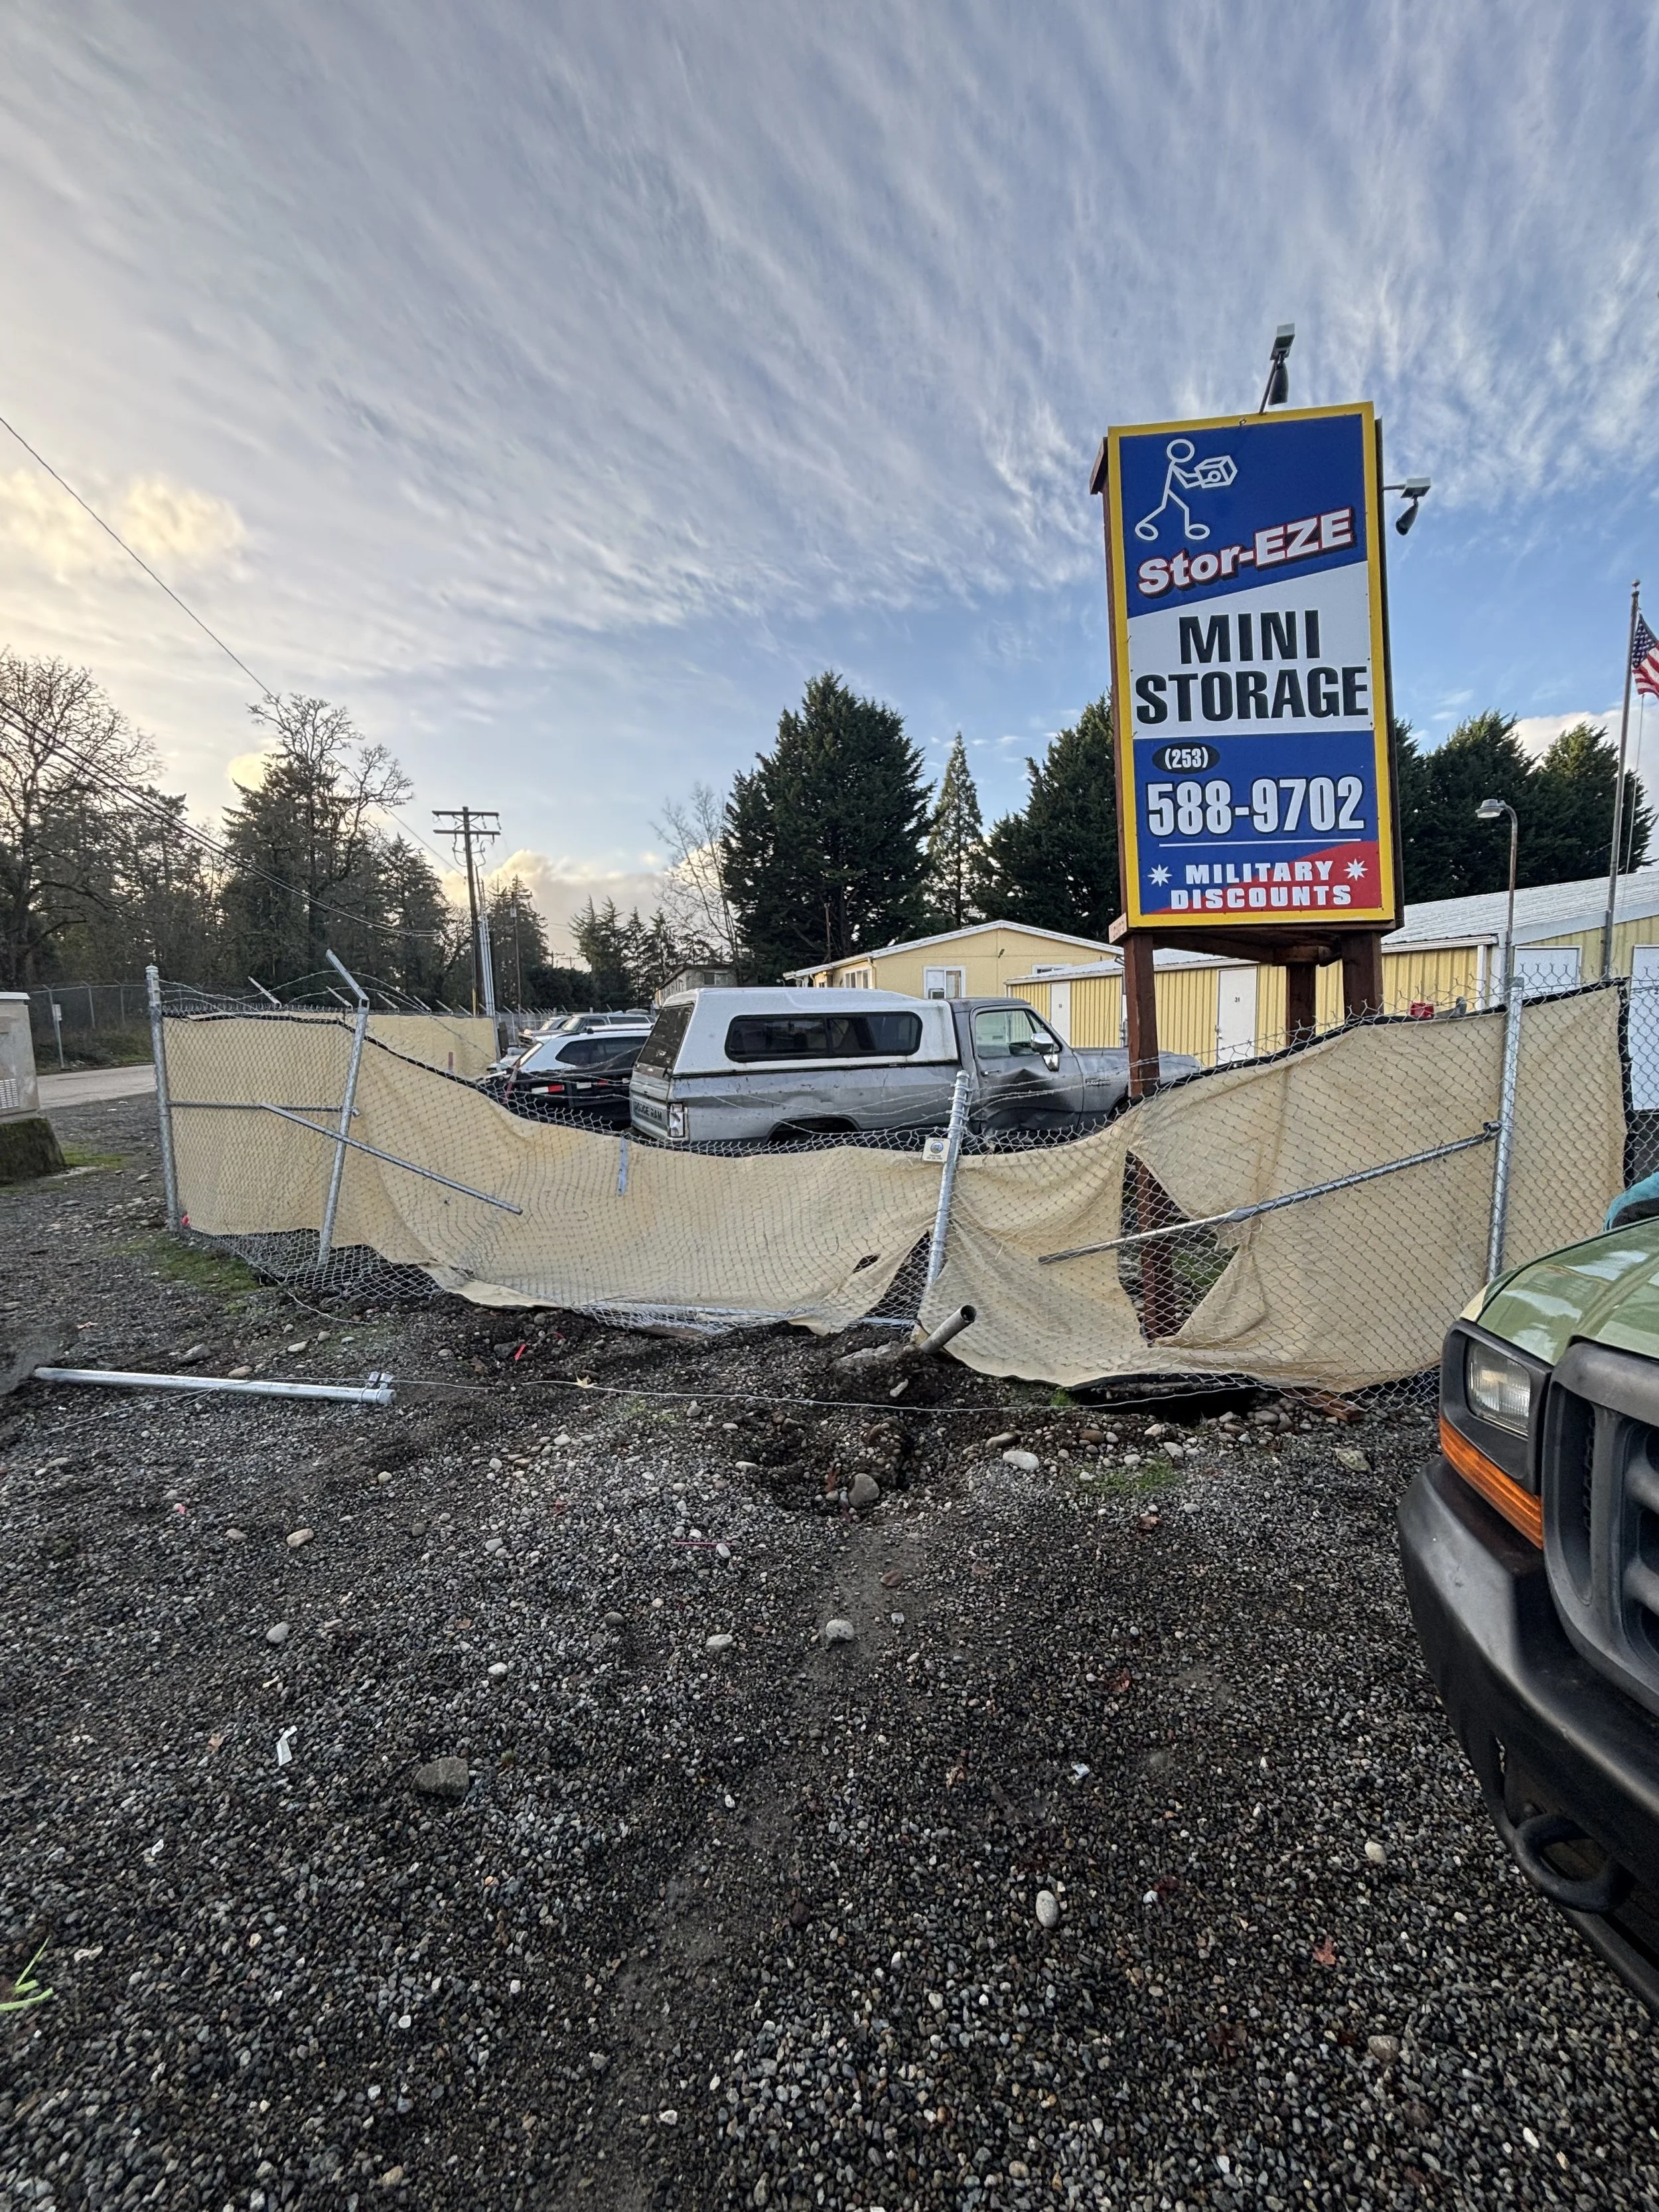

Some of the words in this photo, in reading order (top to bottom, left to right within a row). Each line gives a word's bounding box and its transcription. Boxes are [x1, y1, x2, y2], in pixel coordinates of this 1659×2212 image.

[1137, 506, 1354, 595] Stor-EZE
[1179, 609, 1320, 665] MINI
[1135, 666, 1369, 724] STORAGE
[1164, 747, 1209, 770] (253)
[1148, 776, 1364, 836] 588-9702
[1170, 885, 1351, 911] DISCOUNTS
[1185, 860, 1333, 885] MILITARY
